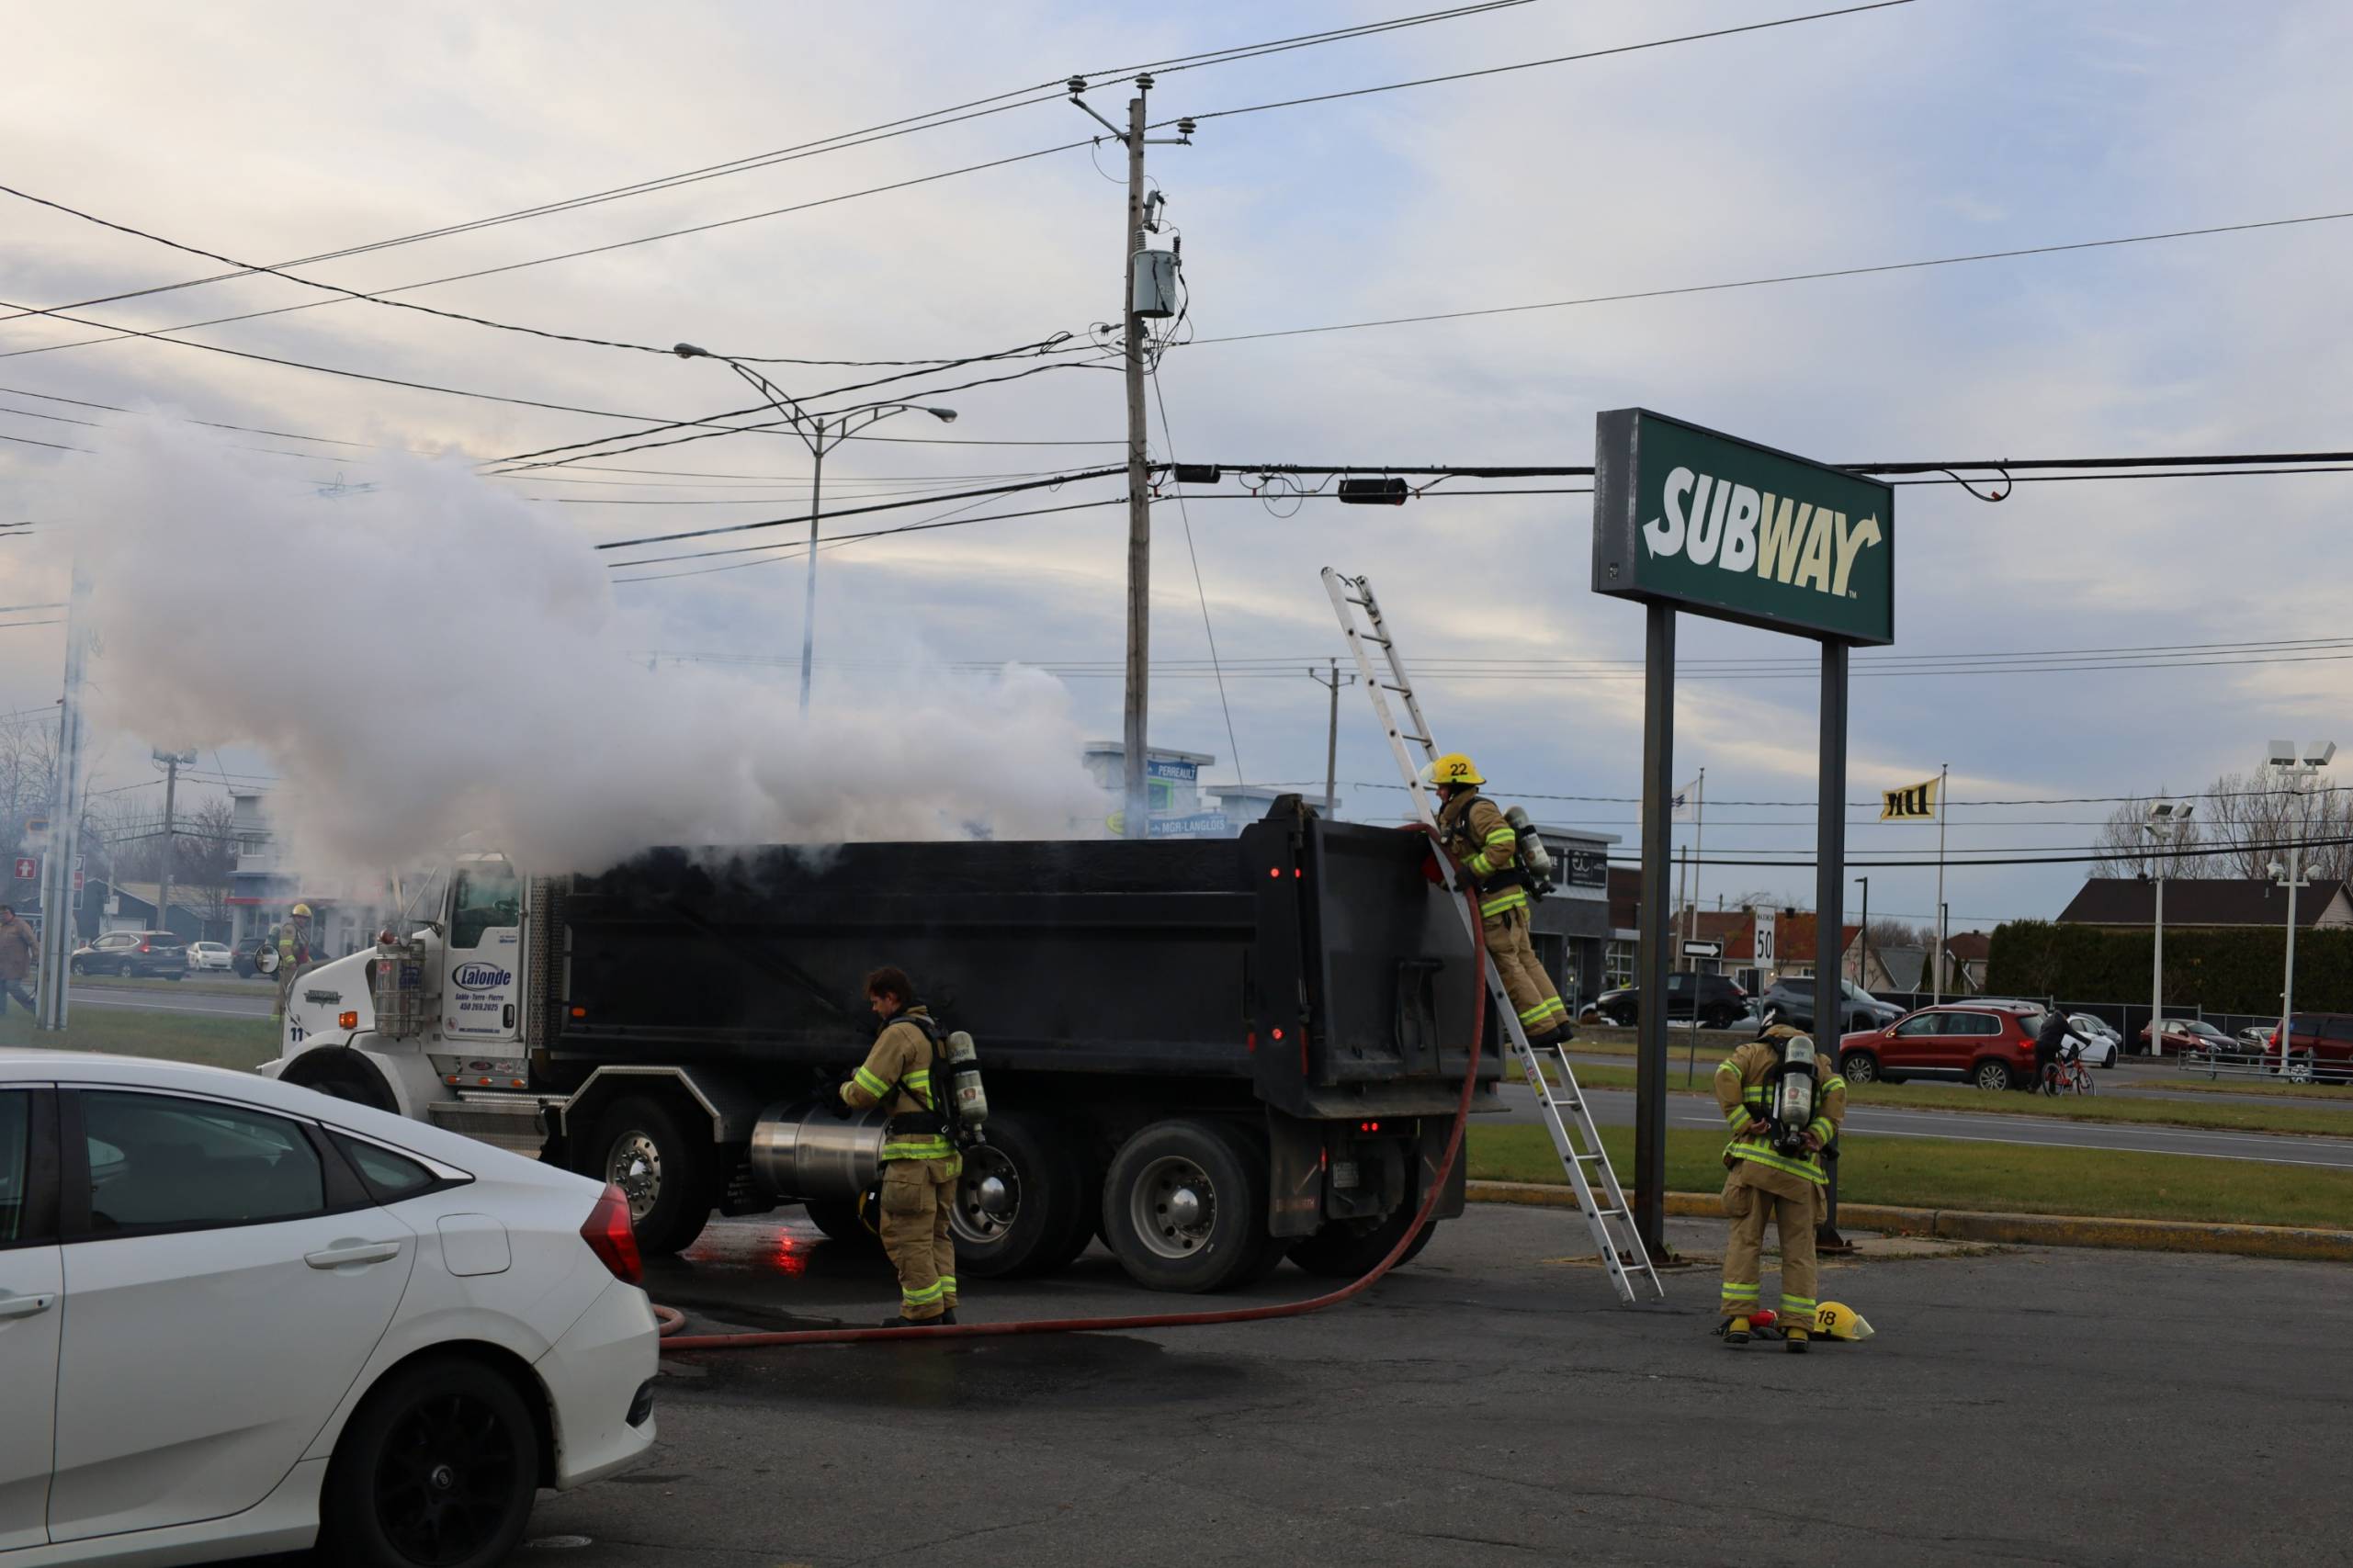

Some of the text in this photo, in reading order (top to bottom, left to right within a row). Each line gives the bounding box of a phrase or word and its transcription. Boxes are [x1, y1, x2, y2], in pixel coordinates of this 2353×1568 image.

[1643, 467, 1882, 597] SUBWAY
[1159, 765, 1195, 779] PERREAULT
[1450, 763, 1468, 776] 22
[1162, 819, 1226, 833] MGR-LANGLOIS
[1757, 930, 1773, 960] 50
[461, 968, 512, 985] Lalonde
[460, 1002, 470, 1010] 450
[290, 1027, 304, 1042] 11
[1818, 1309, 1837, 1325] 18
